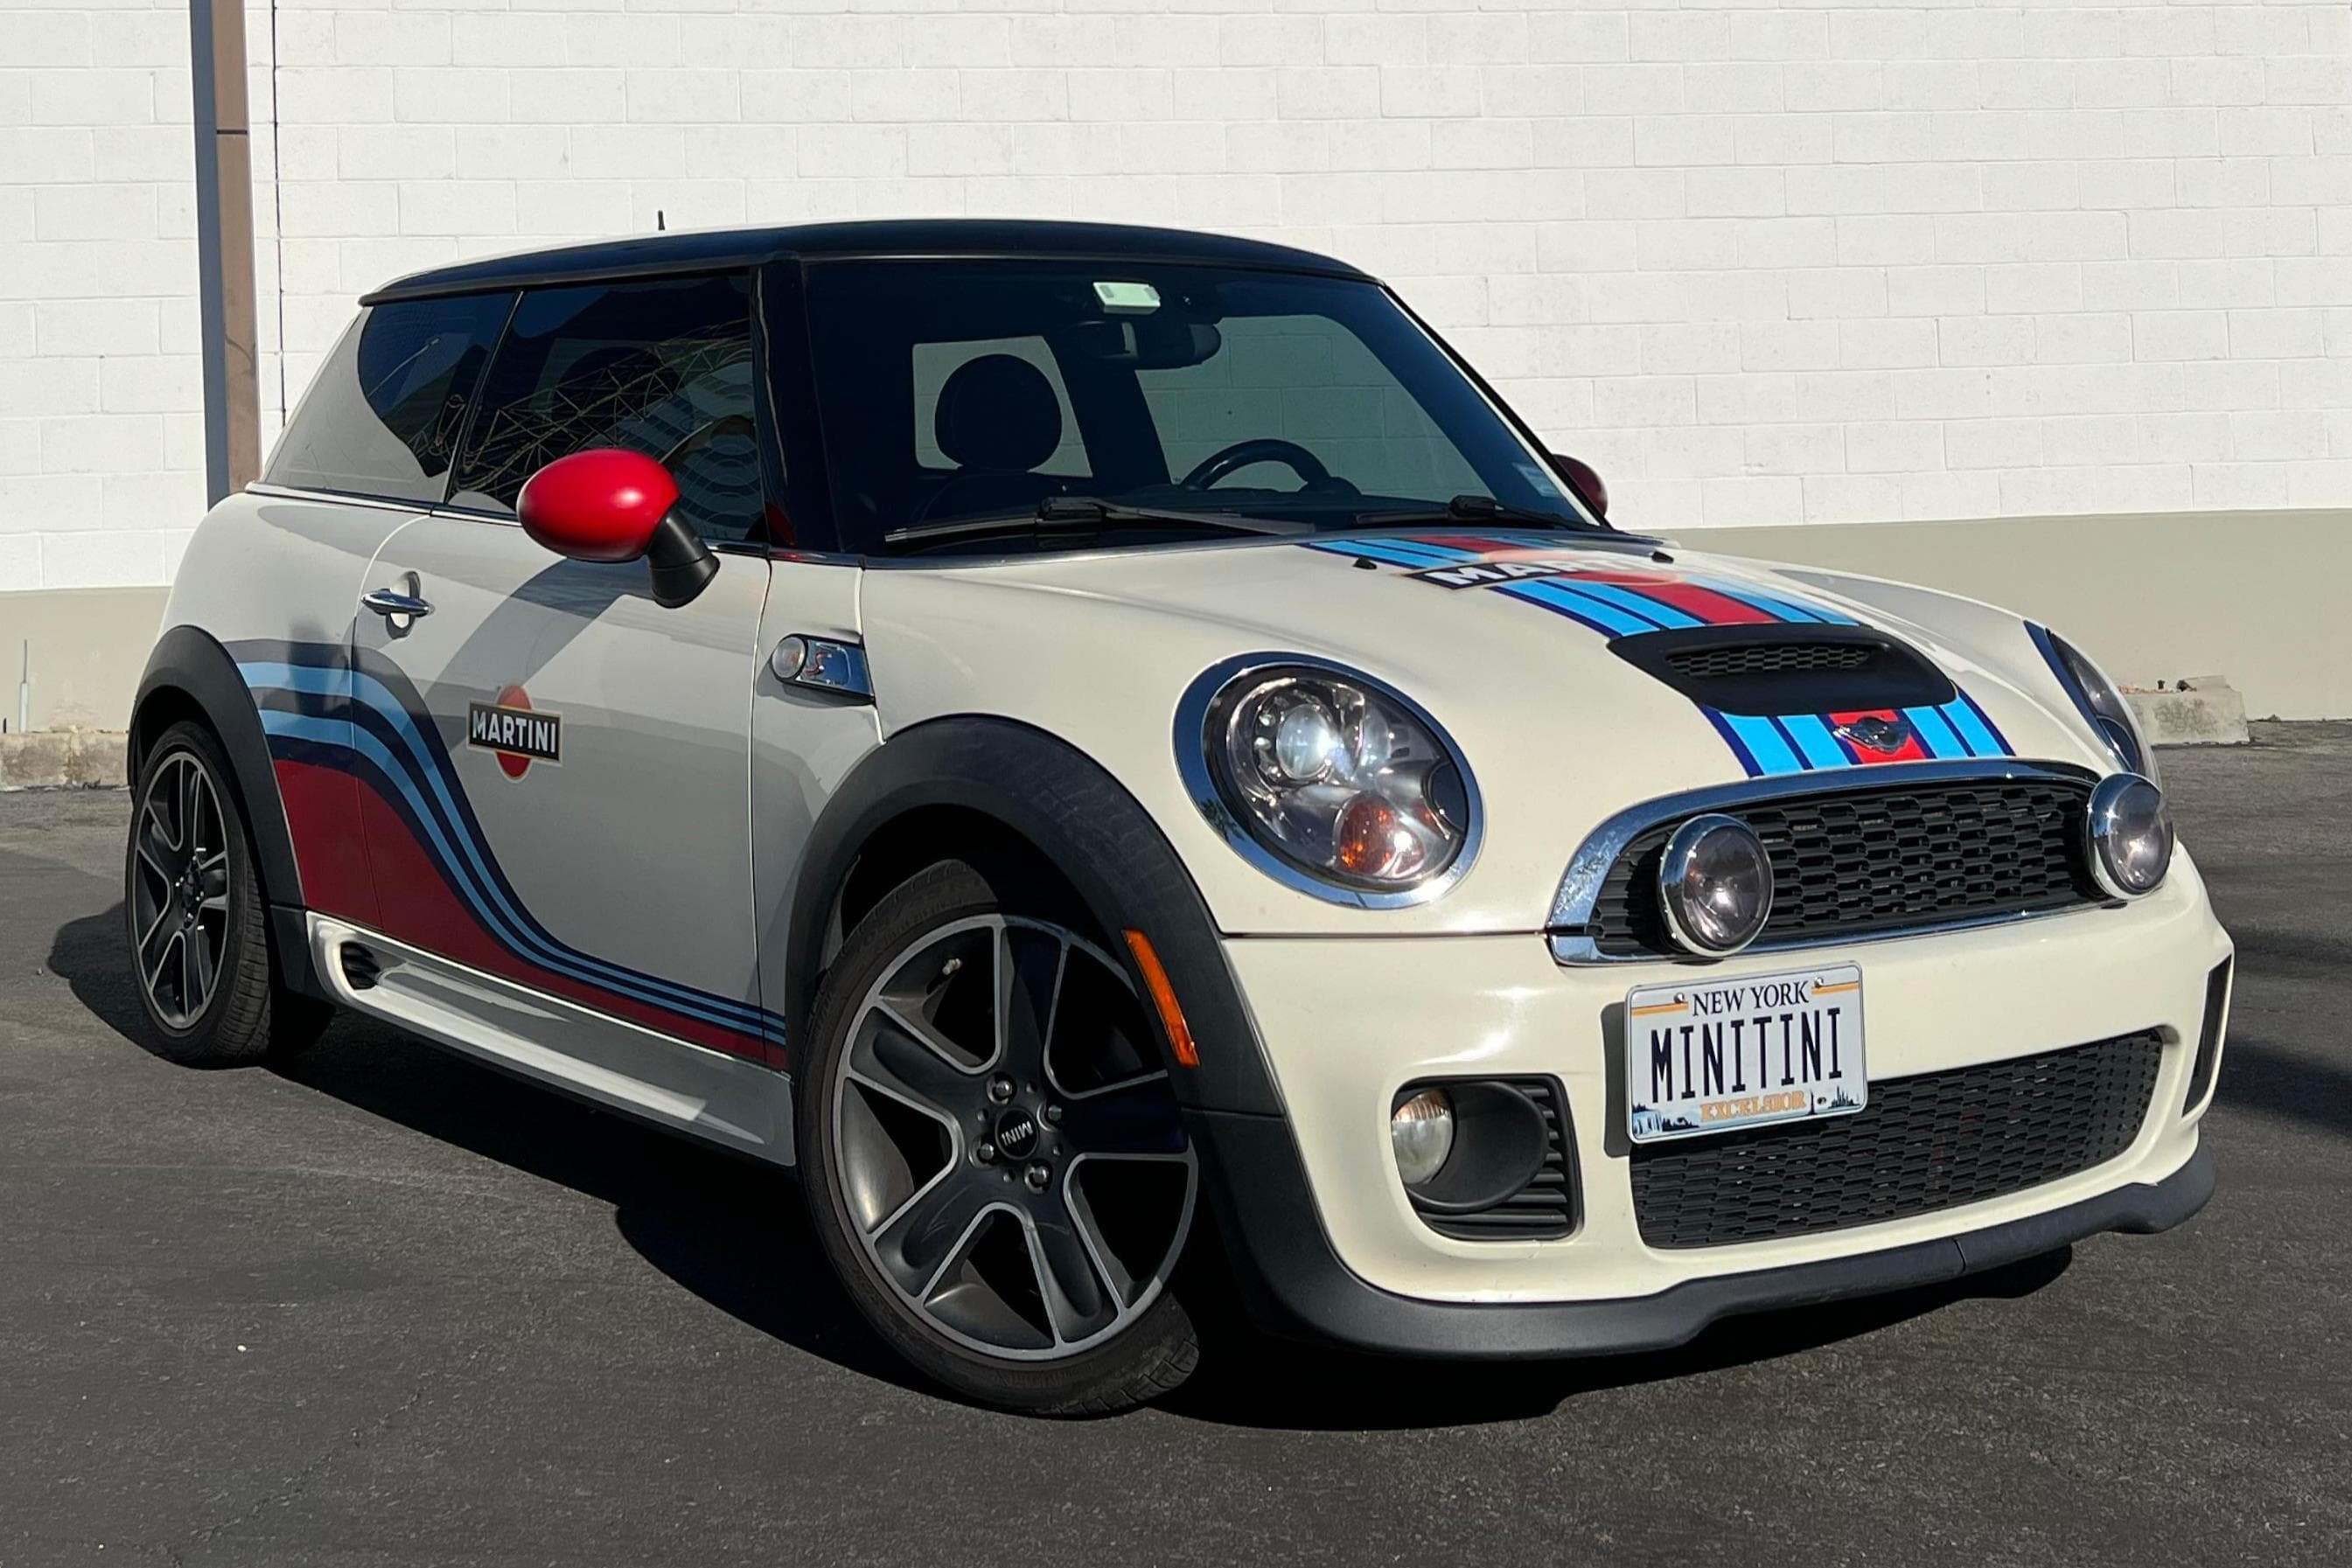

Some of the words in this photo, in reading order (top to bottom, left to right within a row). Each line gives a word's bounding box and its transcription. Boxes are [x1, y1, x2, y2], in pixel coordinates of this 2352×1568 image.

[1424, 559, 1666, 585] MARTI
[471, 709, 556, 754] MARTINI
[1692, 987, 1744, 1017] NEW
[1749, 979, 1810, 1009] YORK
[1651, 1007, 1842, 1104] MINITINI
[1699, 1090, 1807, 1123] EXCELSIOR
[1001, 1120, 1034, 1146] MINI
